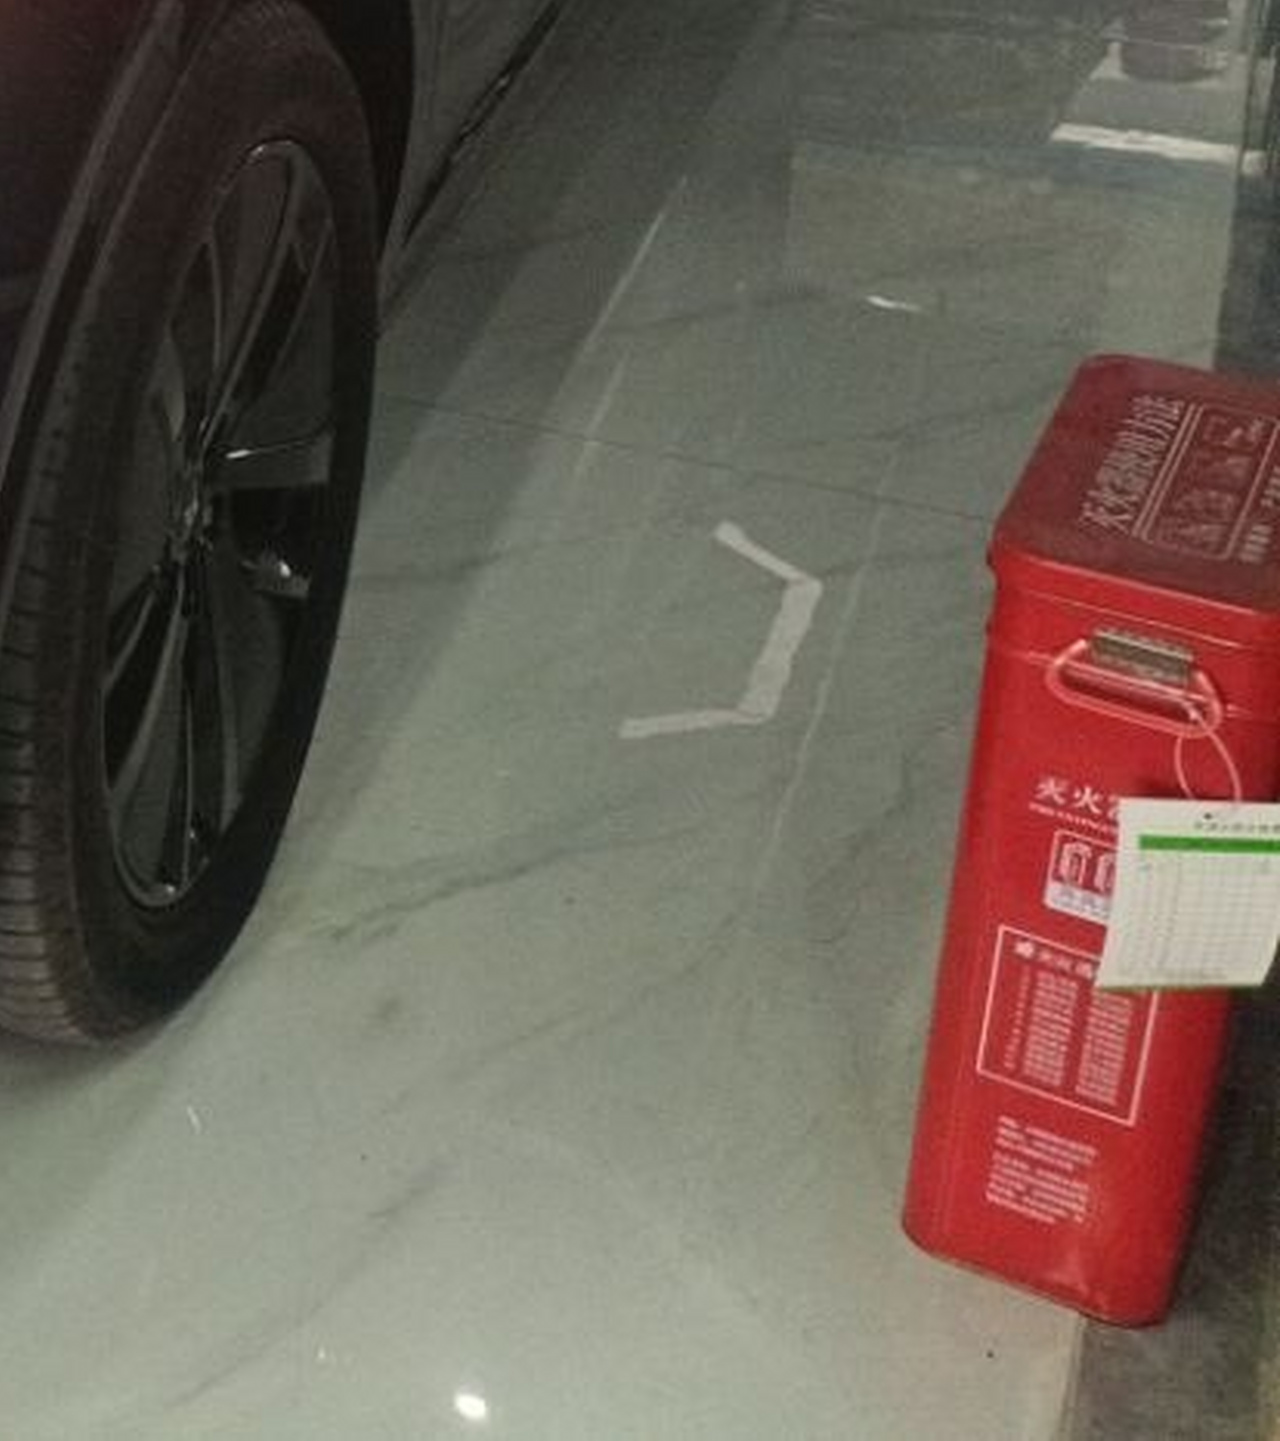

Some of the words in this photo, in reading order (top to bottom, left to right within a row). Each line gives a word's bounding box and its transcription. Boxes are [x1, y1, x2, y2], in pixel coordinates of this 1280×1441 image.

[1079, 395, 1185, 535] 灭火器使用方法
